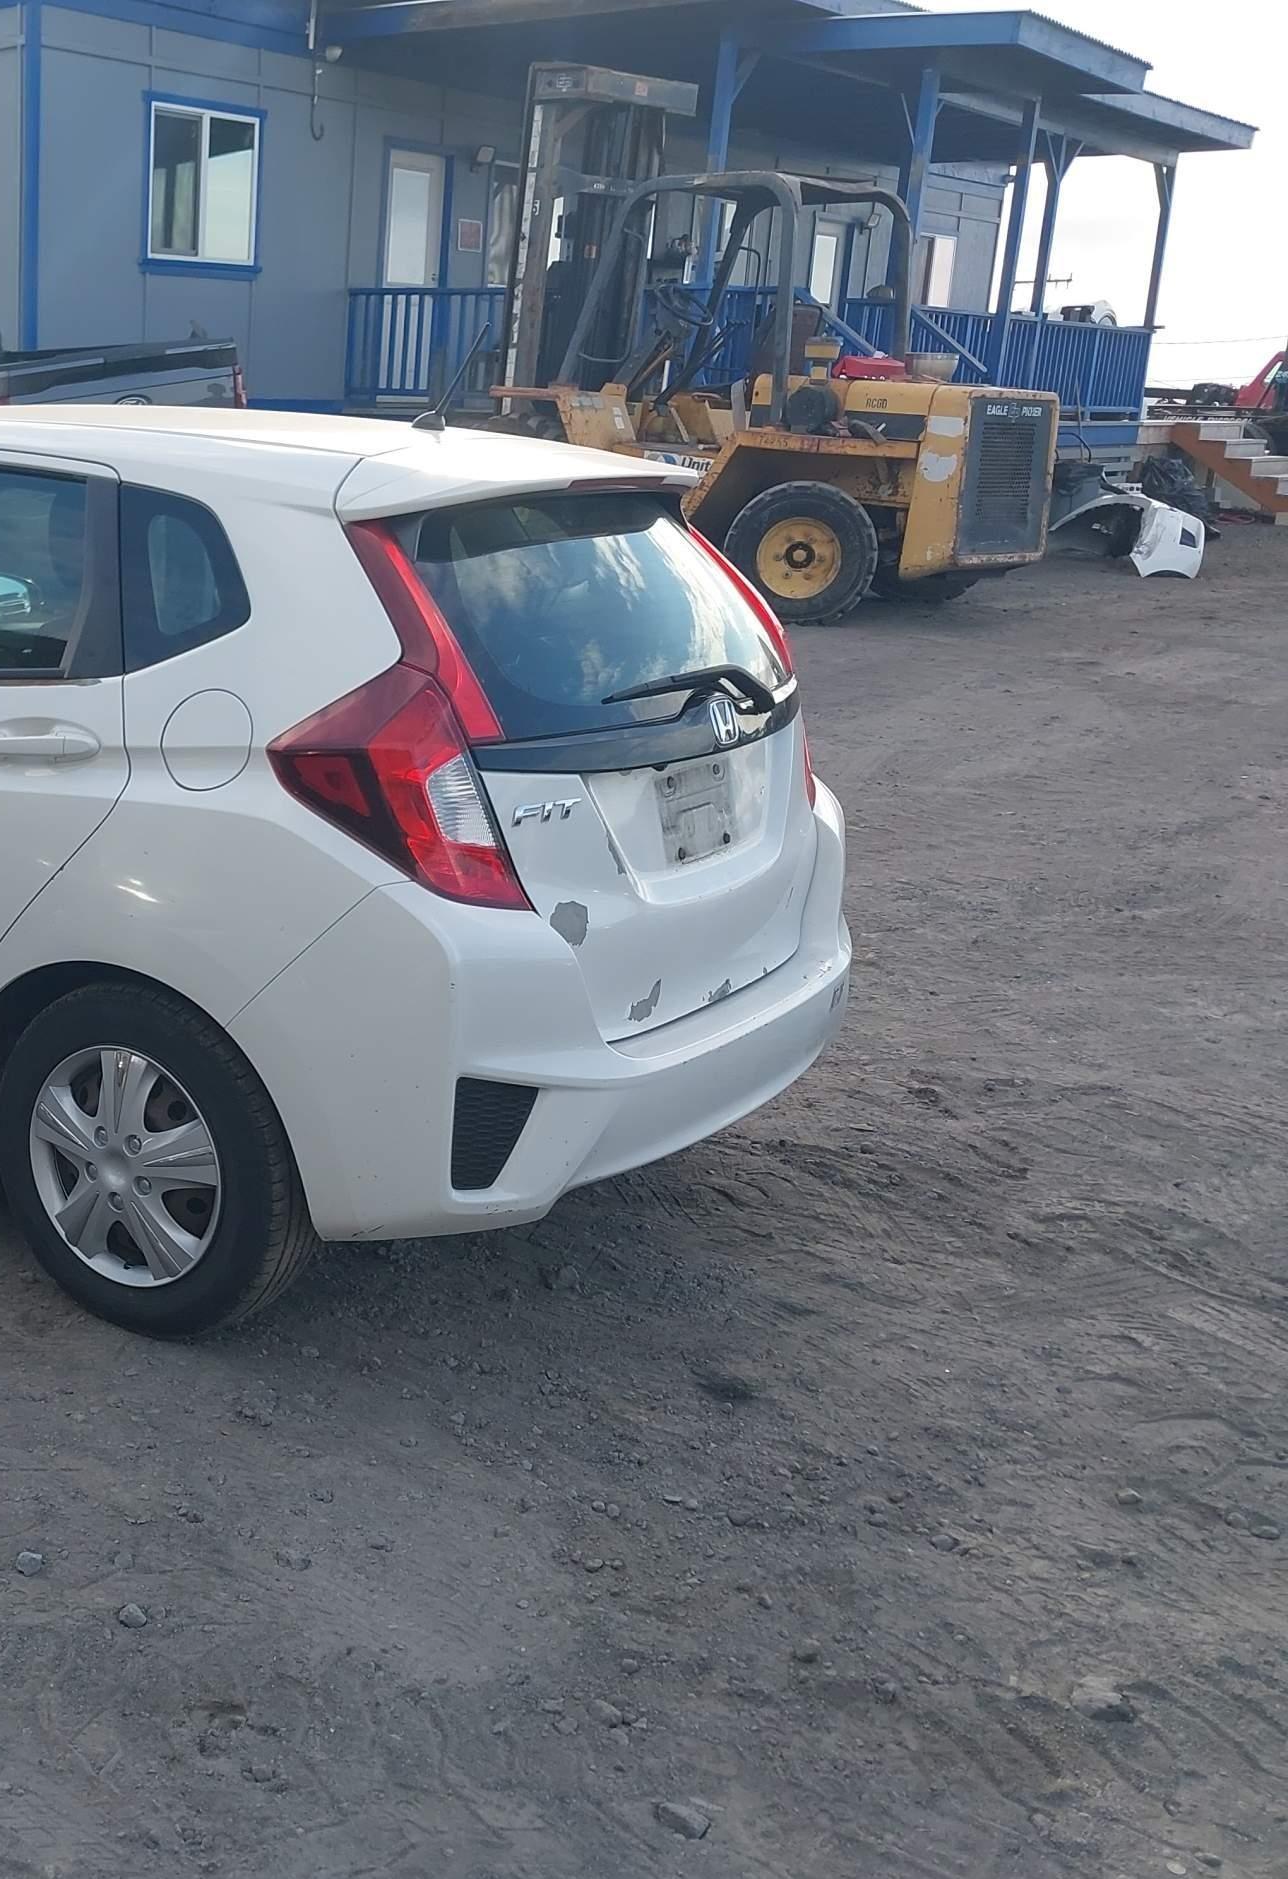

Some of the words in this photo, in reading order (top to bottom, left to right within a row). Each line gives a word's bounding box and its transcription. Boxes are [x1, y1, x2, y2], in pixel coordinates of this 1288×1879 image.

[986, 404, 1009, 416] EAGLE
[681, 457, 713, 472] Unit
[512, 798, 582, 827] FIT
